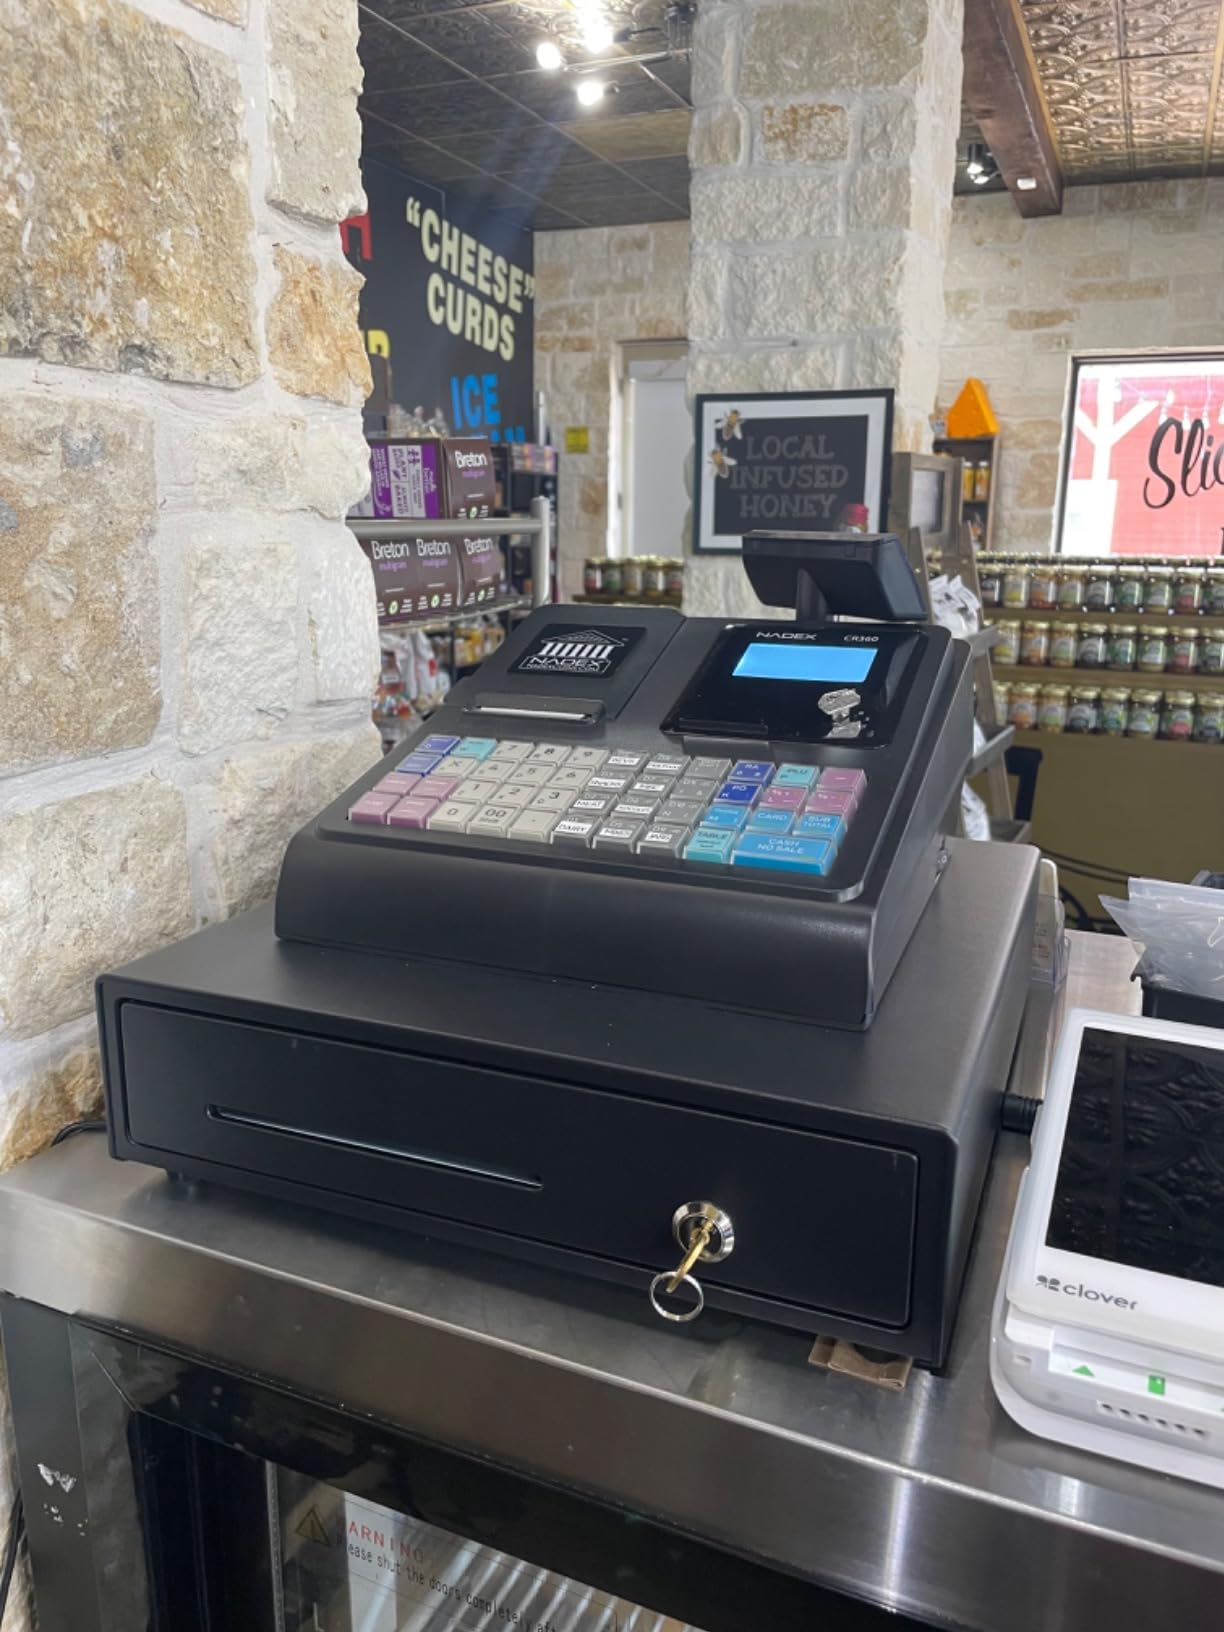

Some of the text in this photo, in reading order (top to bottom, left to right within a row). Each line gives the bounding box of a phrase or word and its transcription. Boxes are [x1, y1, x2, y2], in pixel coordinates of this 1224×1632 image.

[427, 272, 515, 361] CURDS
[451, 373, 501, 430] ICE
[745, 434, 836, 460] LOCAL
[454, 450, 488, 469] Breton
[729, 464, 849, 489] INFUSED
[739, 493, 838, 518] HONEY
[371, 540, 411, 560] Breton
[416, 538, 451, 556] Breton
[464, 537, 494, 554] Breton
[756, 631, 879, 643] NADEX CR360
[530, 656, 604, 668] NADEX
[549, 791, 560, 799] 3
[447, 807, 458, 815] 0
[485, 808, 507, 818] 00
[757, 843, 804, 854] NO SALE
[769, 838, 800, 847] CASH
[1063, 1283, 1139, 1310] clover
[346, 1520, 424, 1563] ARNING
[348, 1543, 373, 1564] ease
[377, 1554, 401, 1576] shut
[406, 1564, 424, 1585] the
[429, 1577, 461, 1600] doors
[465, 1593, 532, 1632] complete
